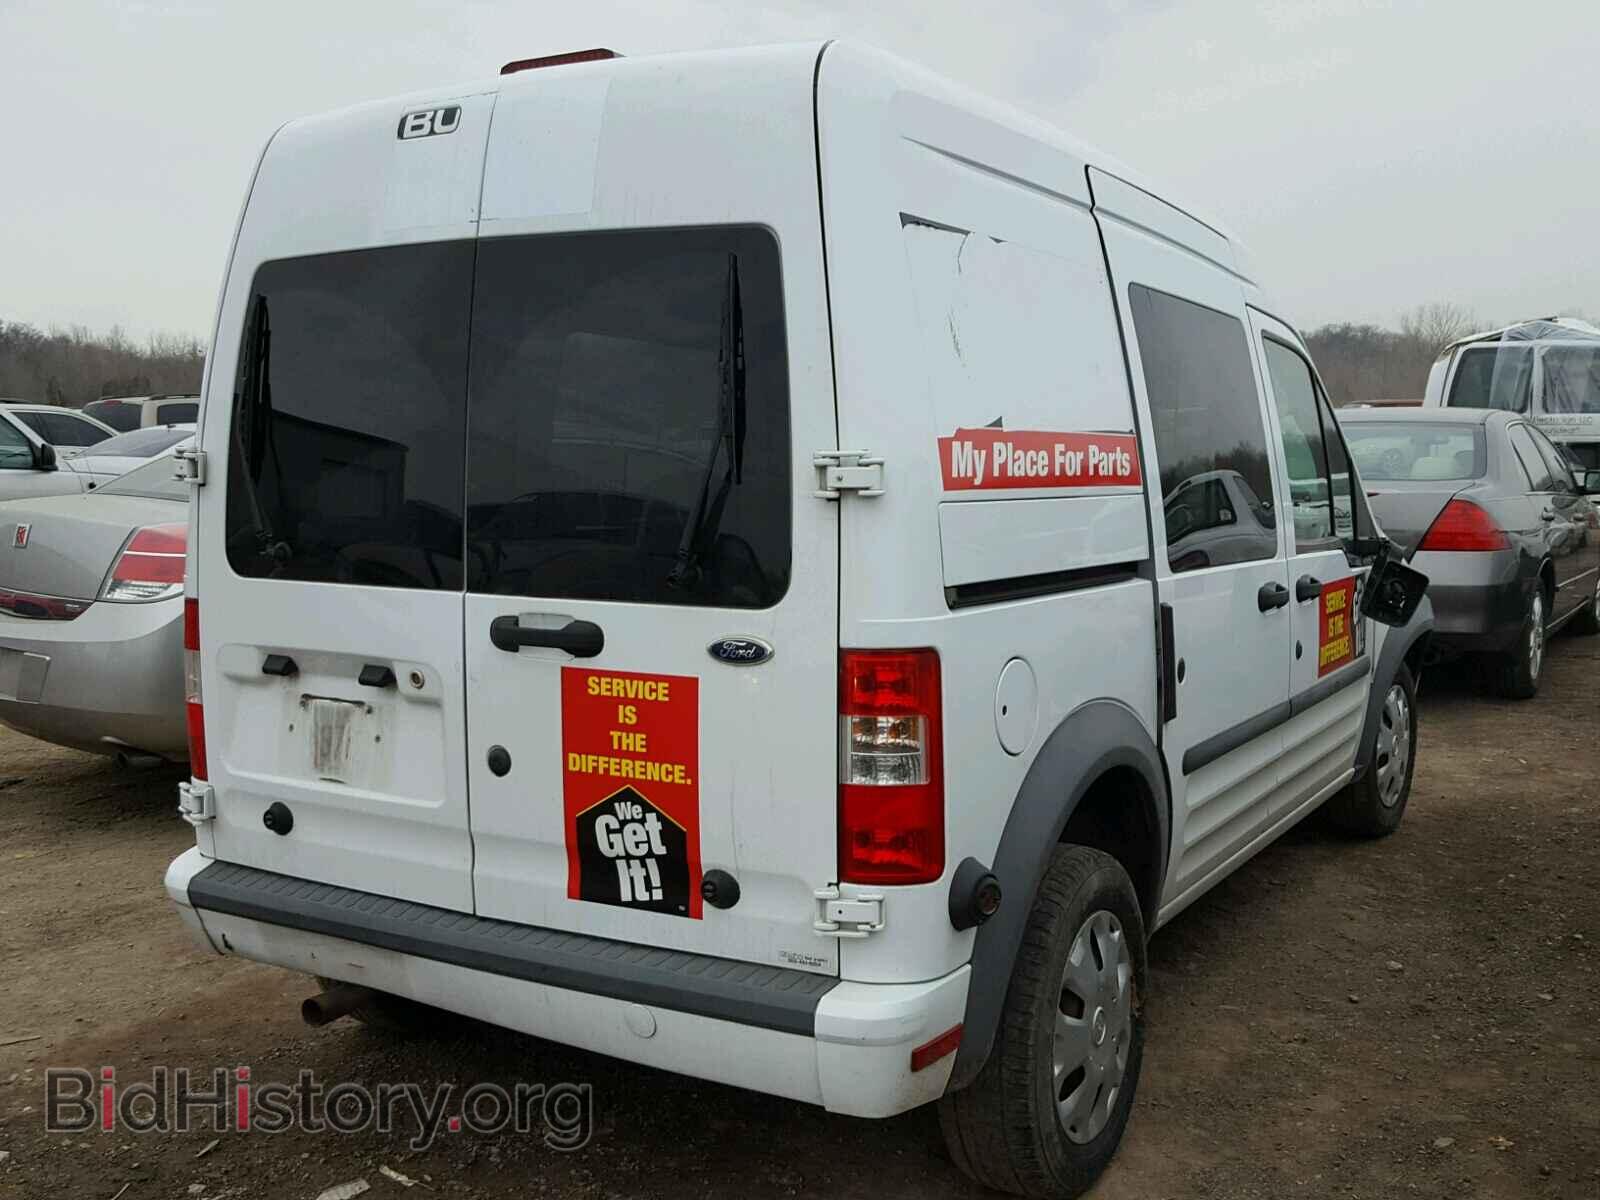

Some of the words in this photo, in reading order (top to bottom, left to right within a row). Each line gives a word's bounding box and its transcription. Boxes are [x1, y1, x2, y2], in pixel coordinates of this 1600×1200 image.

[401, 107, 461, 138] BU
[951, 440, 986, 486] My
[992, 441, 1049, 478] Place
[1054, 443, 1084, 477] For
[1088, 444, 1131, 477] Parts
[720, 640, 757, 658] Ford
[587, 676, 670, 701] SERVICE
[618, 704, 637, 725] IS
[609, 730, 647, 753] THE
[567, 752, 692, 785] DIFFERENCE.
[613, 801, 643, 821] We
[594, 812, 668, 858] Get
[615, 857, 664, 902] It!
